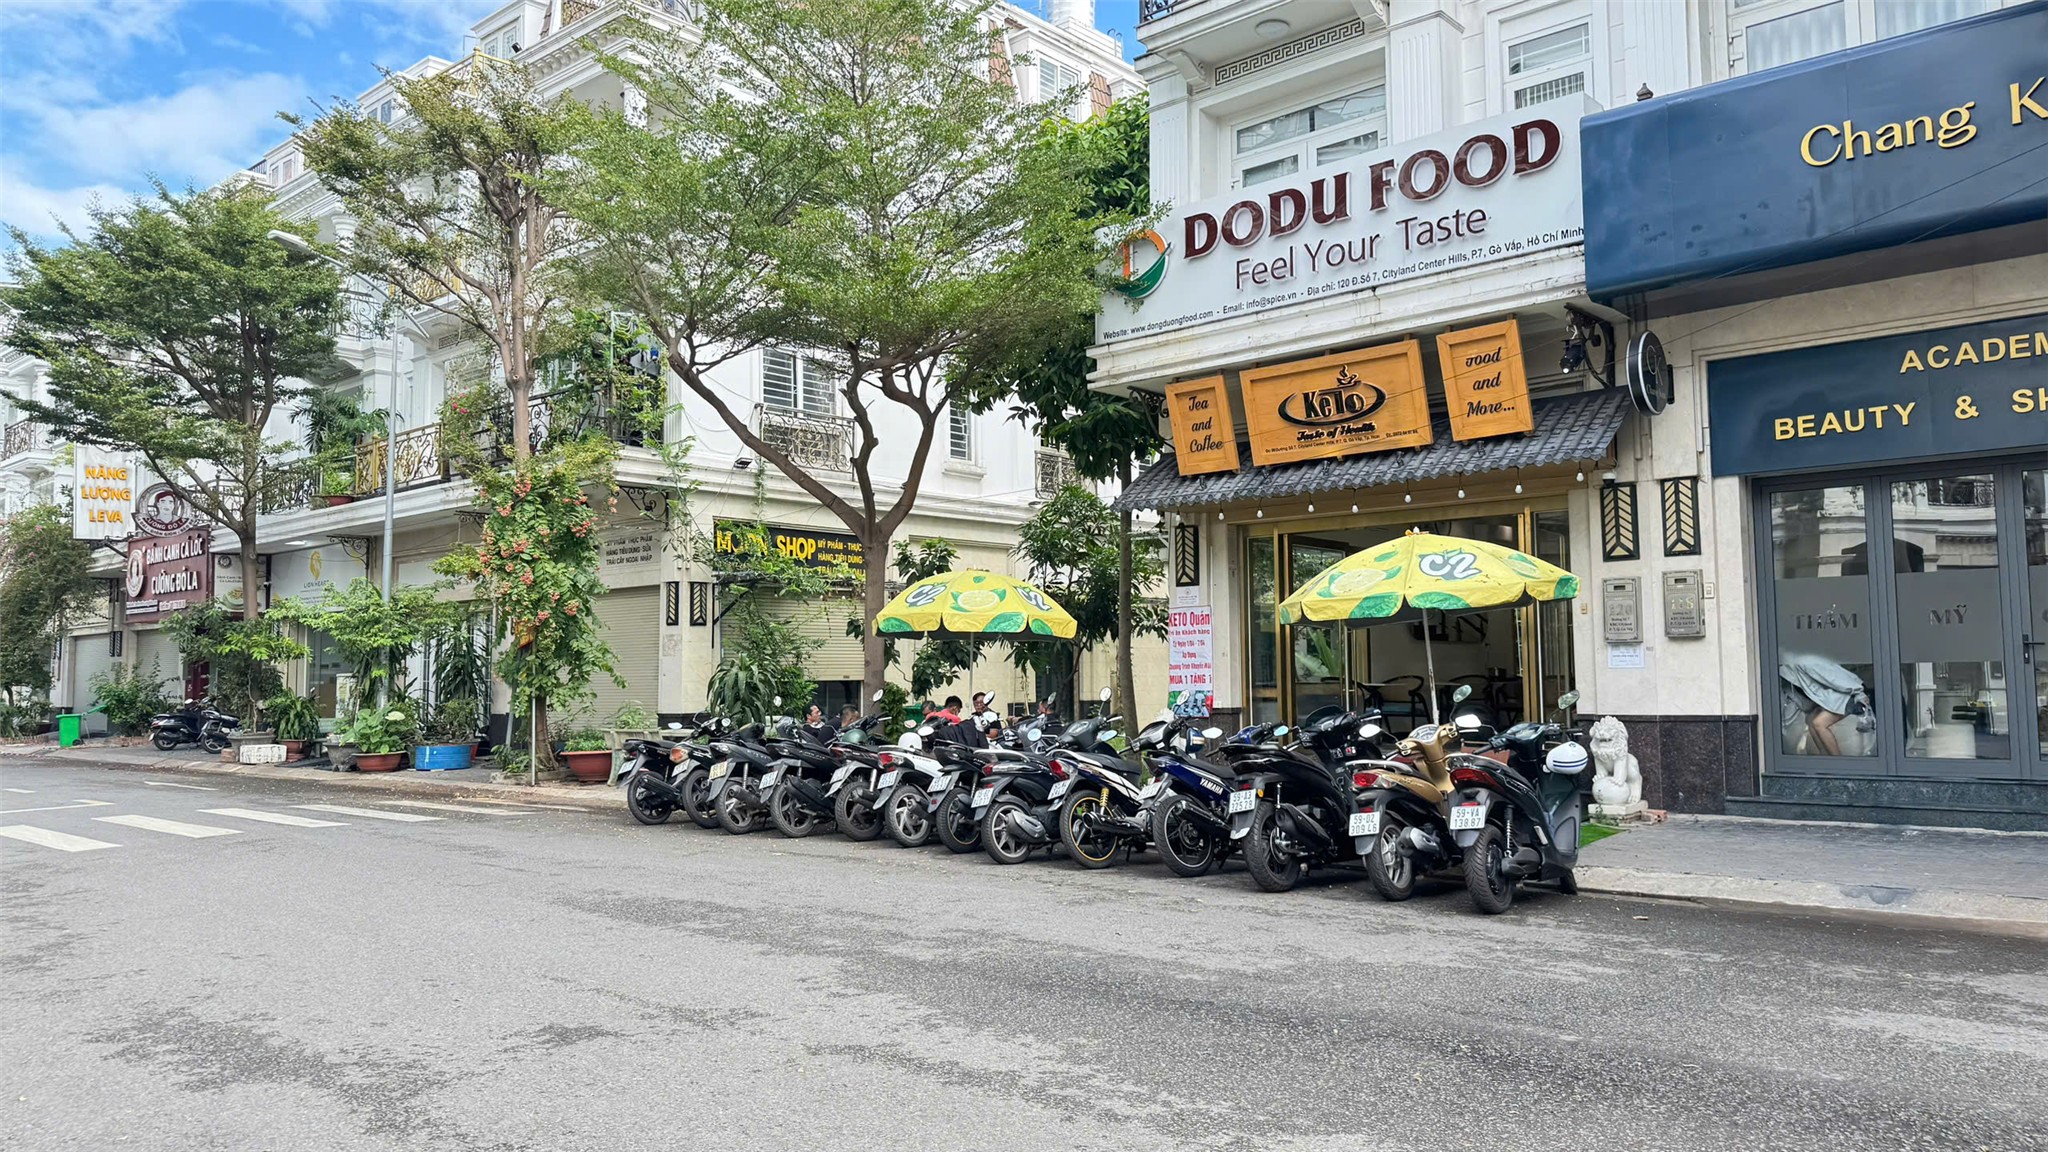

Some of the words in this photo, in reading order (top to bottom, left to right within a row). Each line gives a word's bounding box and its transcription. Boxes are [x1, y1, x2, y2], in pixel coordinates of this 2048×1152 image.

[1800, 101, 1977, 166] Chang
[1183, 171, 1352, 260] DODU
[1369, 119, 1562, 211] FOOD
[1236, 246, 1296, 290] Feel
[1304, 233, 1380, 272] Your
[1396, 208, 1487, 250] Taste
[1103, 328, 1129, 340] Website:
[1130, 310, 1213, 334] www.dongduongfood.com
[1222, 302, 1245, 315] Email:
[1246, 292, 1297, 310] info@spice.vn
[1307, 285, 1319, 296] Địa
[1337, 277, 1350, 289] 120
[1372, 272, 1380, 283] 7,
[1382, 264, 1416, 280] Cityland
[1418, 259, 1446, 271] Center
[1448, 252, 1470, 265] Hills,
[1471, 249, 1486, 260] P.7,
[1488, 245, 1502, 255] Gò
[1542, 231, 1559, 244] Chí
[1560, 226, 1584, 240] Minh
[1473, 371, 1502, 391] and
[1188, 396, 1210, 411] Tea
[1467, 400, 1515, 418] More...
[1191, 416, 1213, 432] and
[1774, 402, 1916, 441] BEAUTY
[1954, 395, 1980, 419] &
[1190, 434, 1224, 453] Coffee
[85, 465, 127, 480] NĂNG
[81, 486, 131, 503] LƯỢNG
[88, 509, 123, 523] LEVA
[776, 535, 816, 559] SHOP
[1169, 612, 1188, 627] KETO
[1189, 610, 1210, 627] Quán
[1929, 603, 1967, 625] MỸ
[1169, 675, 1183, 685] MUA
[1200, 778, 1223, 795] YAMAHA
